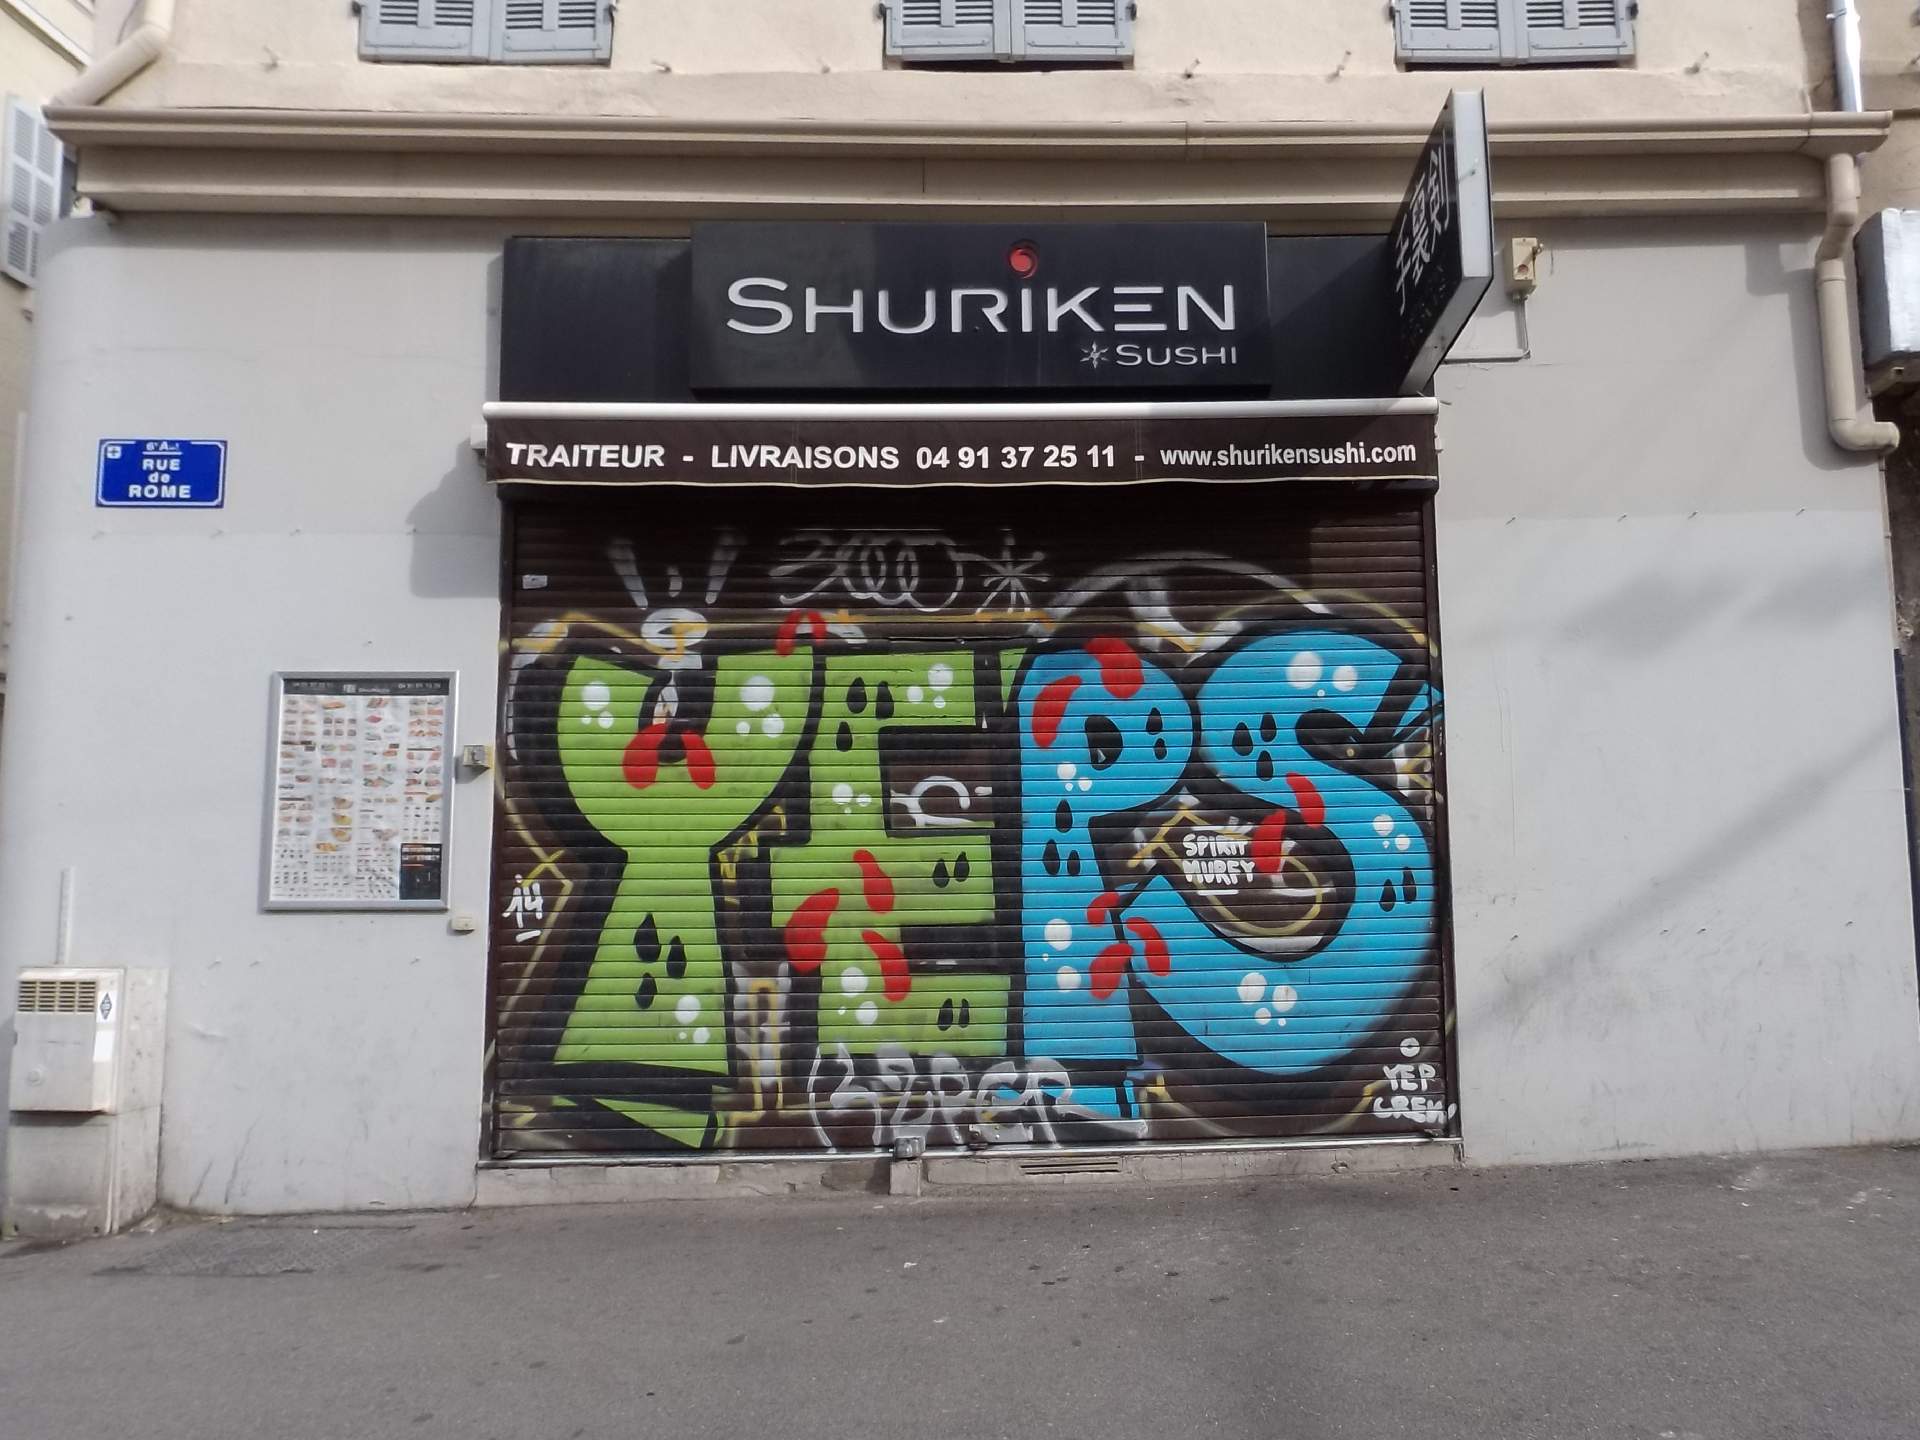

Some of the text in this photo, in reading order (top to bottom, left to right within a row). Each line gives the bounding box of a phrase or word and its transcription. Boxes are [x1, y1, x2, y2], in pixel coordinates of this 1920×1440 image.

[505, 442, 665, 468] TRAITEUR
[711, 445, 900, 469] LIVRAISONS
[916, 446, 950, 469] 04
[958, 446, 990, 469] 91
[1001, 446, 1035, 469] 37
[1043, 445, 1078, 468] 25
[1086, 445, 1114, 467] 11
[1160, 441, 1417, 467] www.shurikensushi.com
[142, 458, 181, 471] RUE
[148, 472, 171, 483] de
[128, 484, 191, 499] ROME
[1382, 1063, 1436, 1091] YEP
